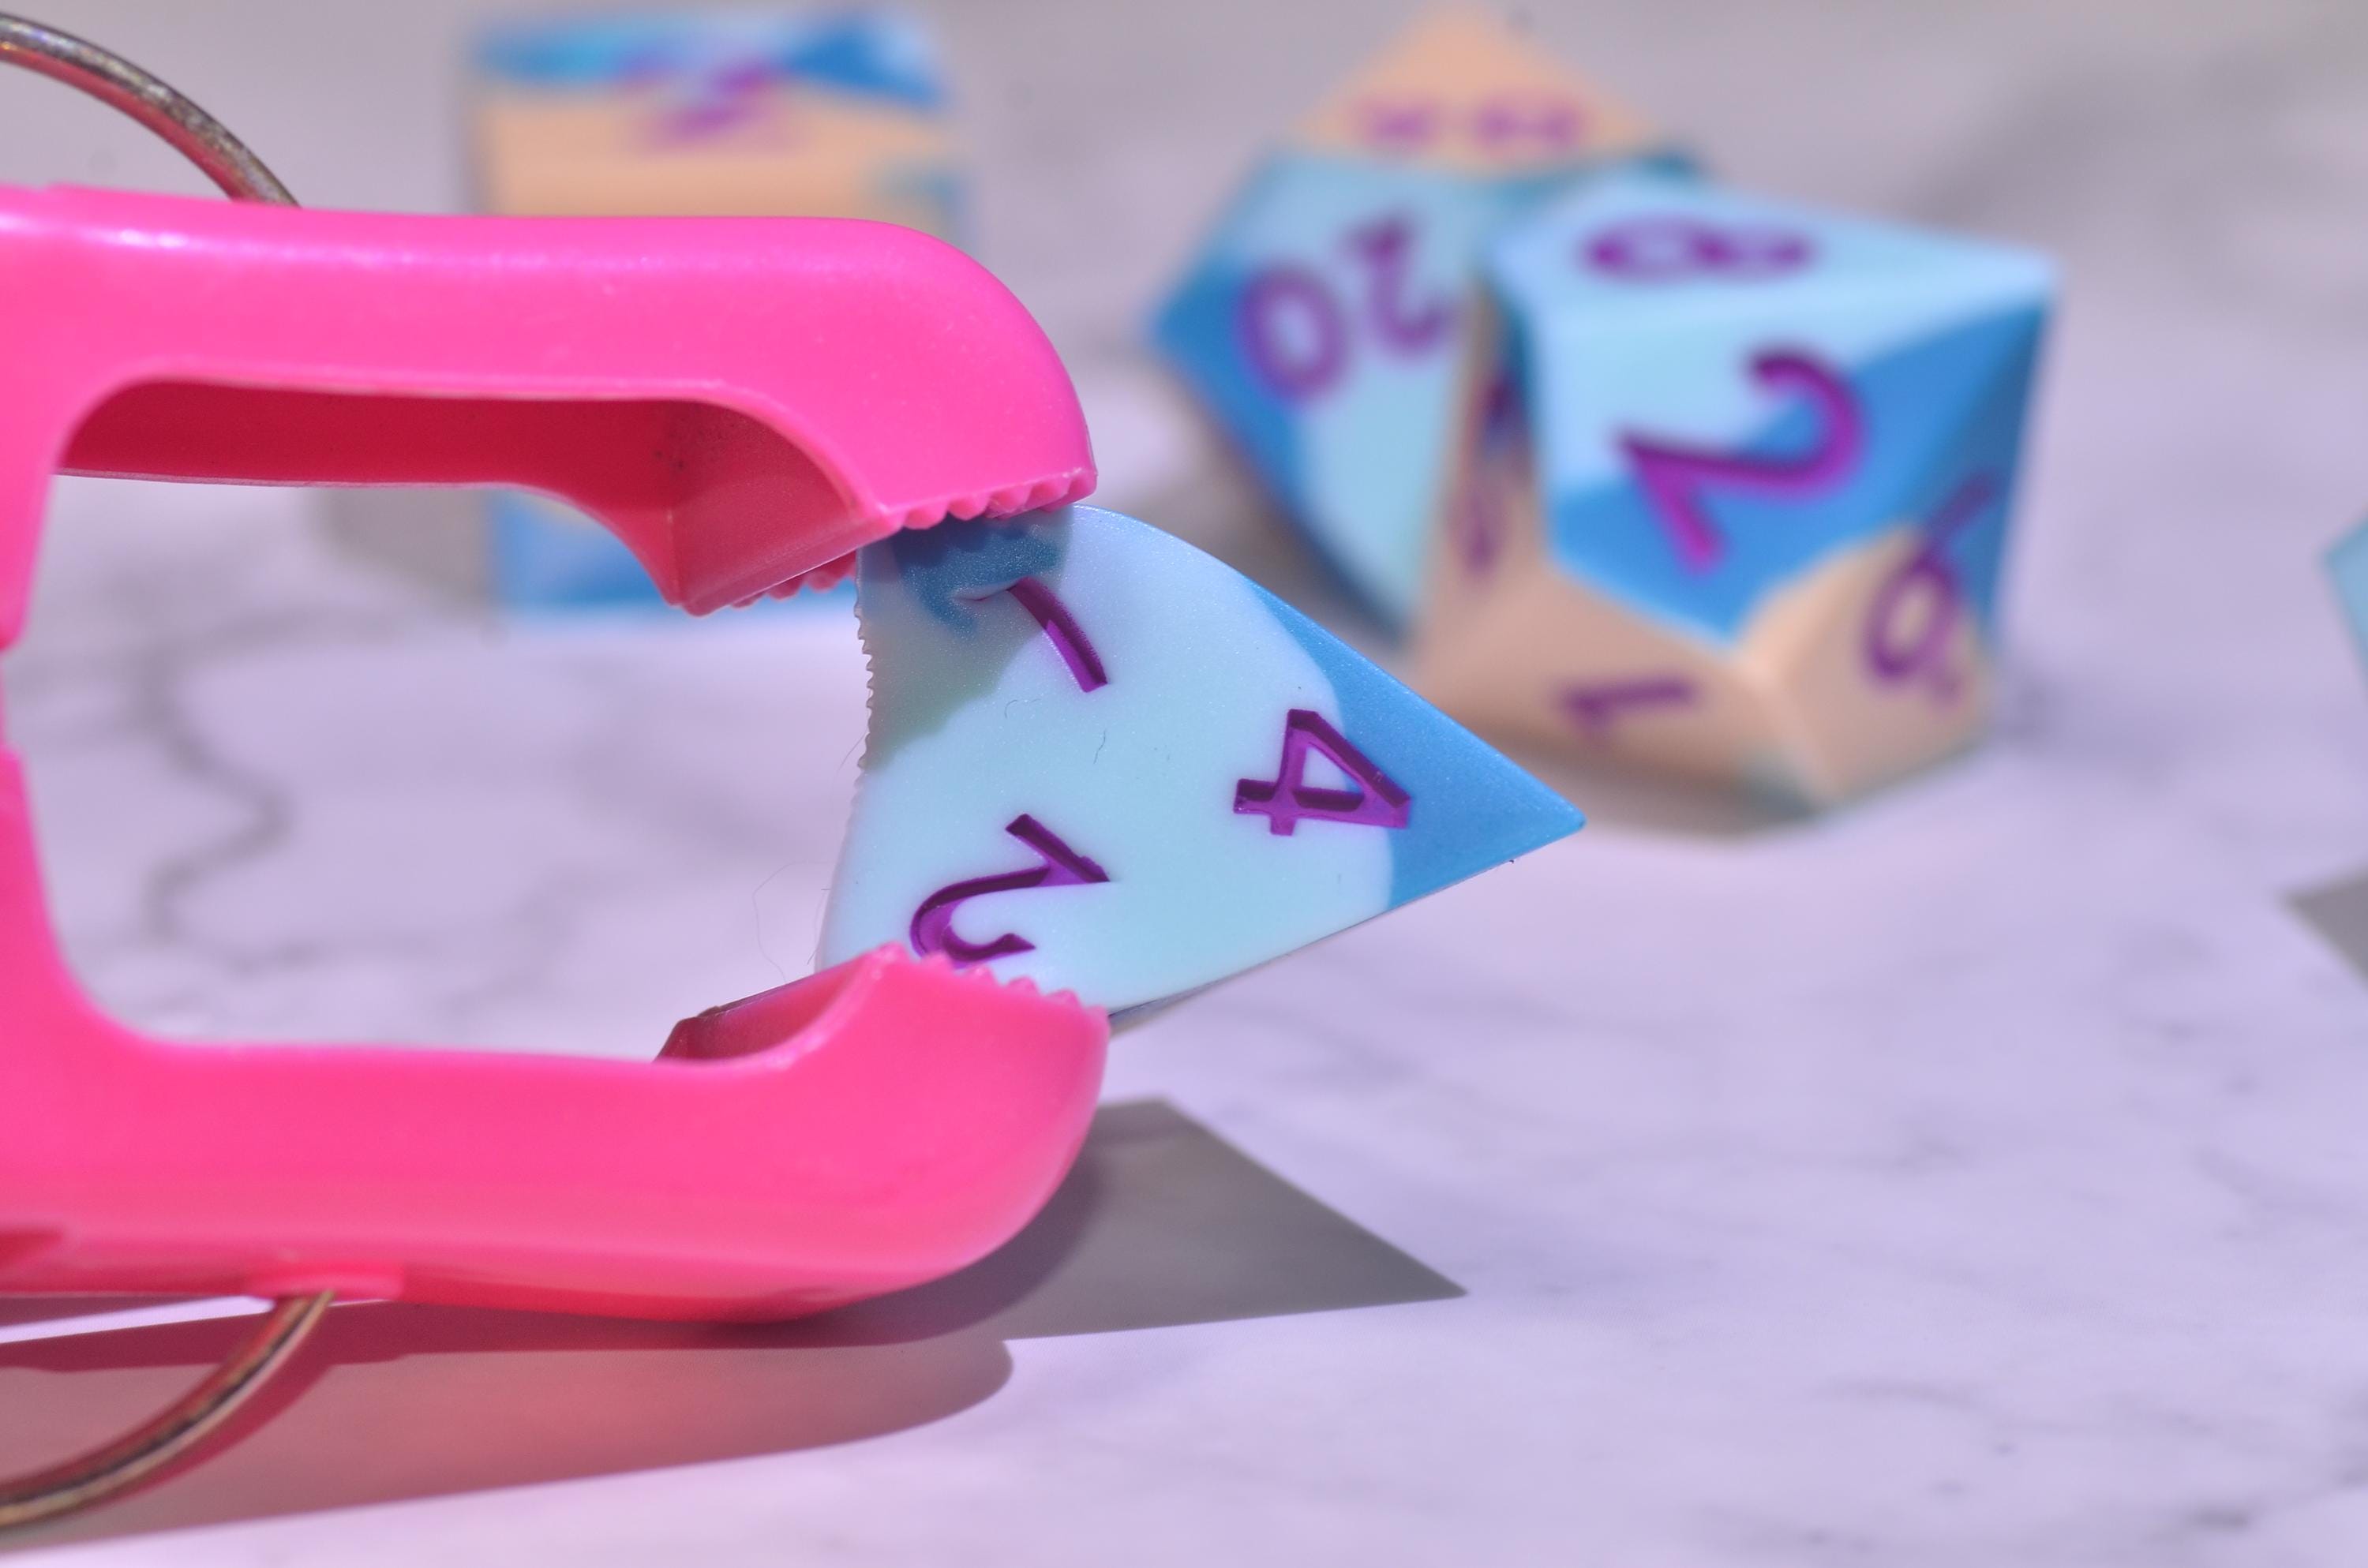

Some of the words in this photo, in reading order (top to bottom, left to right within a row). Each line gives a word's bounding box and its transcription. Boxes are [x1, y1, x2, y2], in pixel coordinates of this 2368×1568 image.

[1615, 344, 1866, 578] 2
[1234, 709, 1411, 835] 4
[910, 814, 1109, 969] 2
